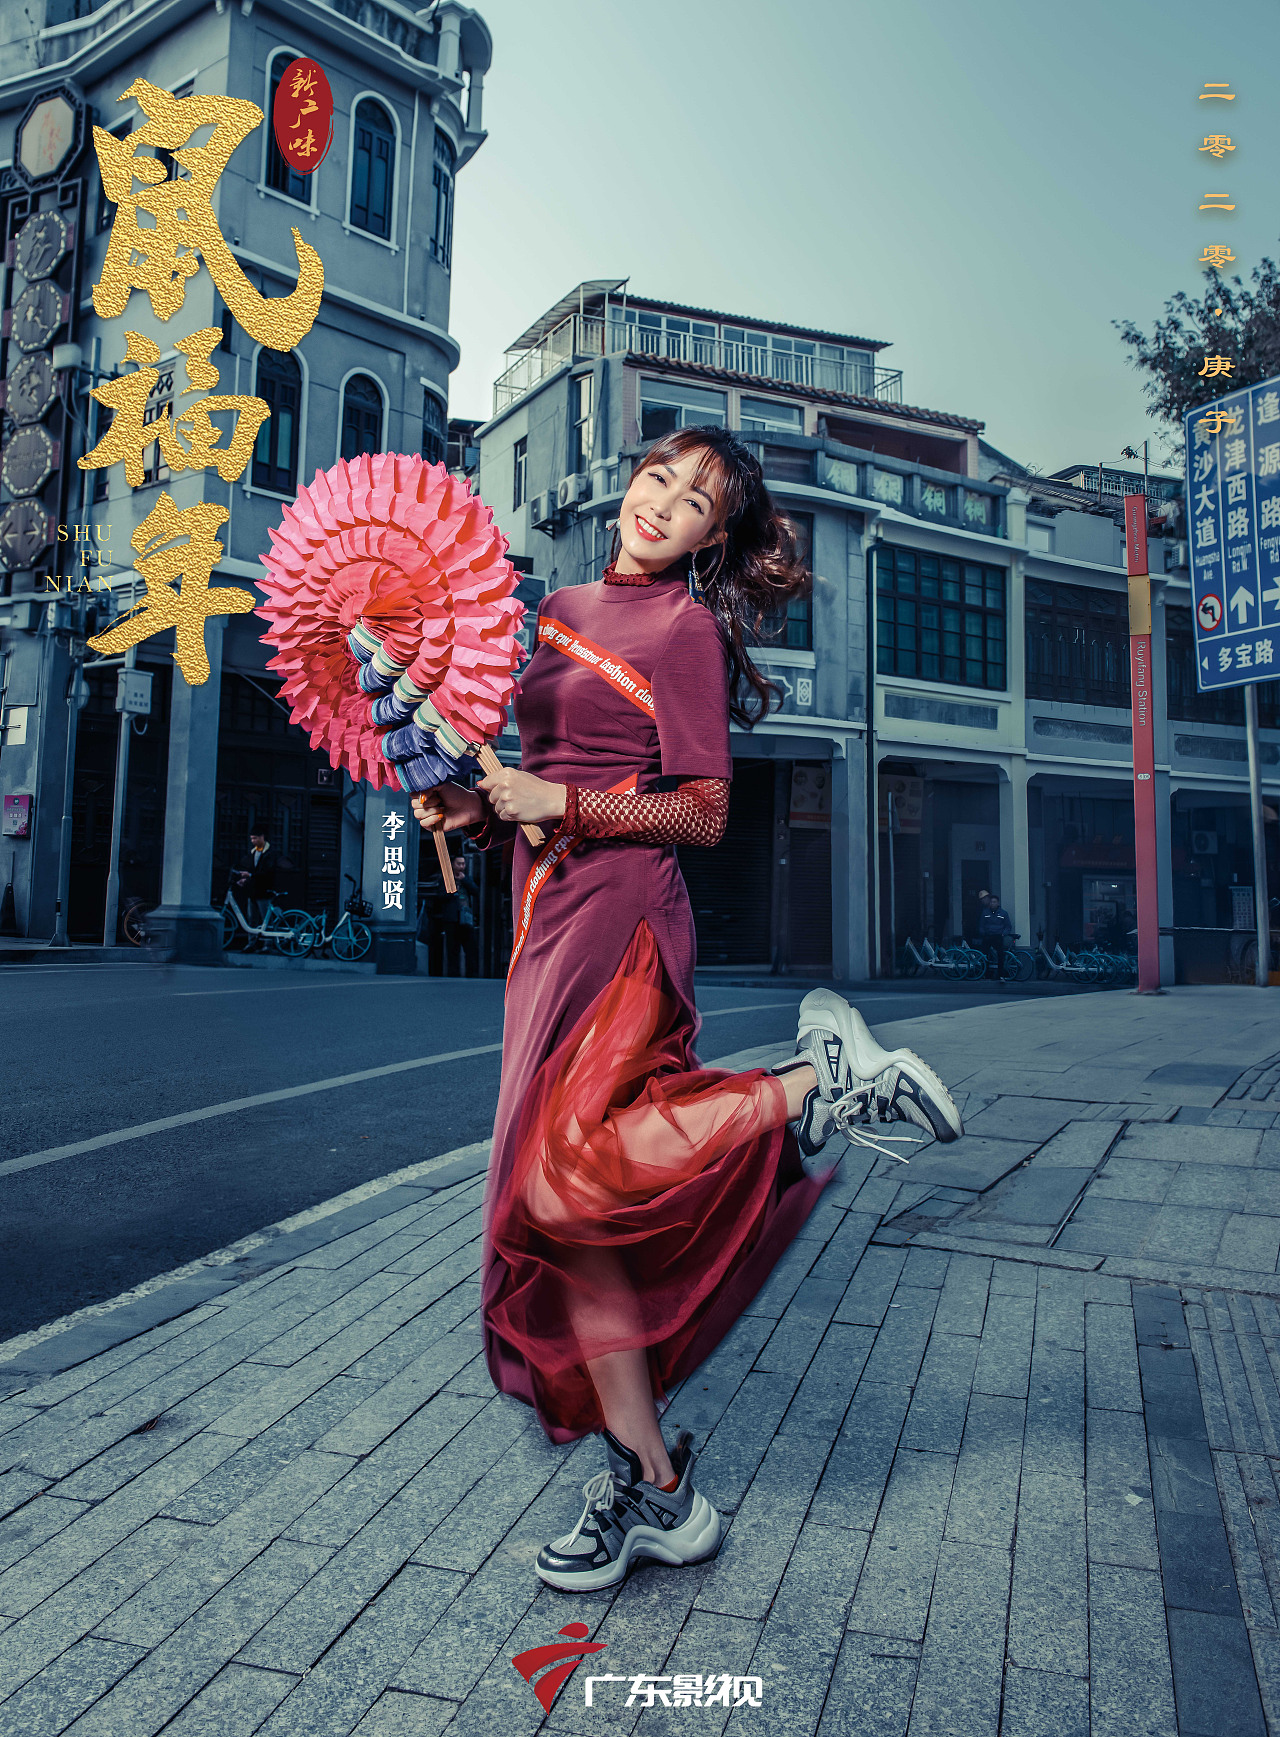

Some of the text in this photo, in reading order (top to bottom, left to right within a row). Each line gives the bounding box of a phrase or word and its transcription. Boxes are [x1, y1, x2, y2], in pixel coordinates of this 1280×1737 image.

[1192, 417, 1218, 549] 黄沙大道
[1224, 404, 1250, 541] 龙津西路
[1134, 641, 1148, 726] Ruyifang Station
[1218, 638, 1274, 673] 多宝路
[529, 849, 558, 893] clothing
